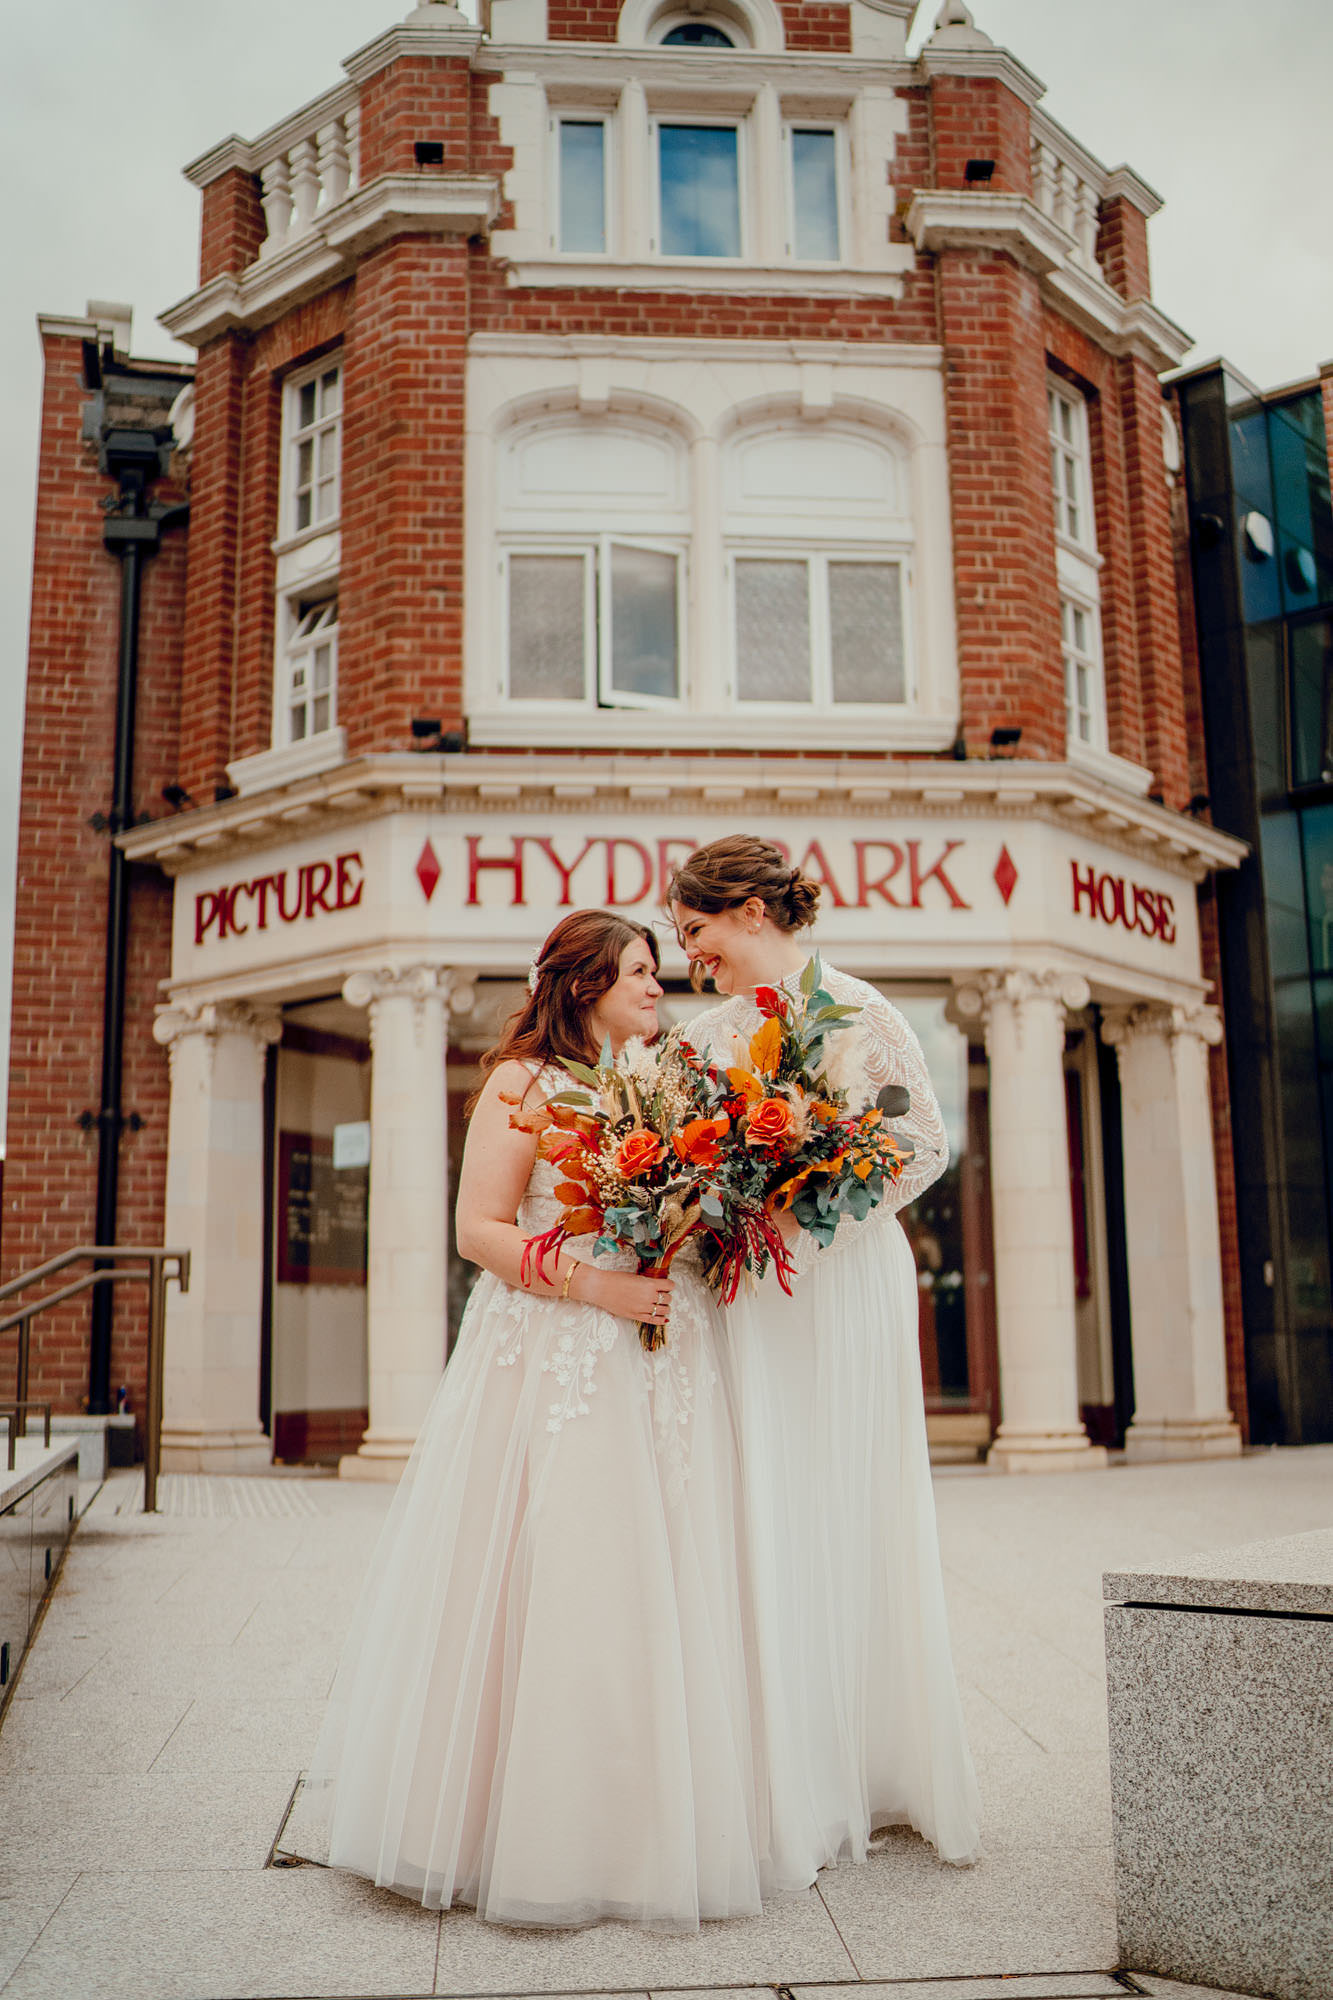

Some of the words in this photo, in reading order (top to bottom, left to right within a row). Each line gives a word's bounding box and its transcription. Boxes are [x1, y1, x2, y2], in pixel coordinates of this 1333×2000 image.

[194, 852, 365, 945] PICTURE
[779, 838, 972, 910] ARK
[1070, 860, 1177, 945] HOUSE
